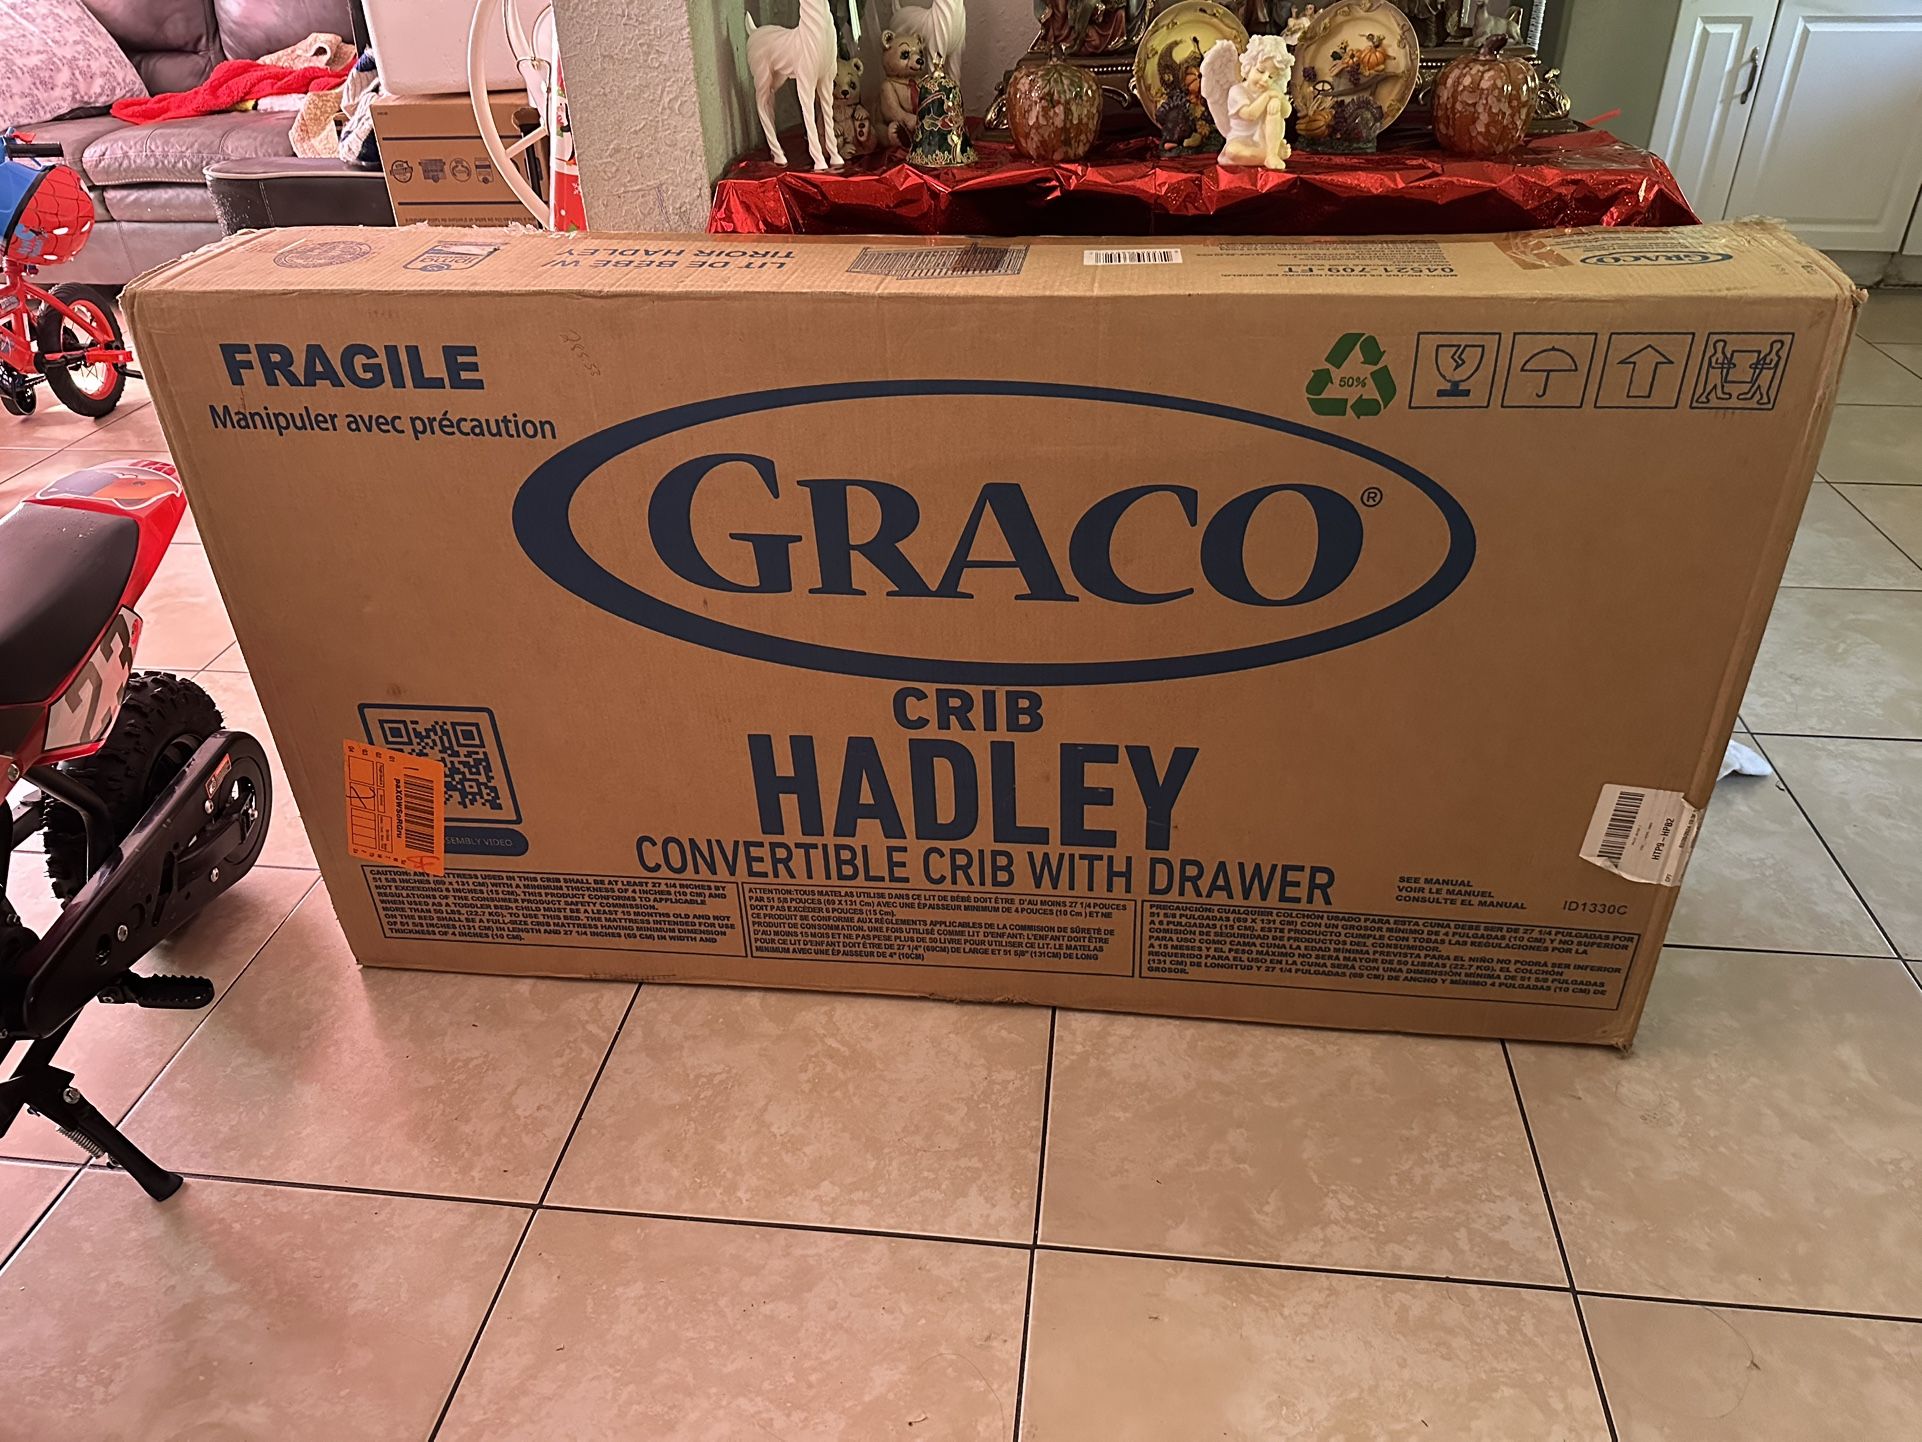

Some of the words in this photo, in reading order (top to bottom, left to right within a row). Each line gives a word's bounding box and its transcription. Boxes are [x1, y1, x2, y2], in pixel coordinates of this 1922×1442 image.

[218, 343, 485, 391] FRAGILE
[1338, 376, 1368, 389] 50%
[209, 403, 339, 438] Manipuler
[345, 412, 405, 434] avec
[410, 408, 557, 442] précaution
[647, 453, 1364, 607] GRACO
[893, 687, 1044, 732] CRIB
[748, 734, 1199, 851] HADLEY
[636, 835, 910, 885] CONVERTIBLE
[923, 847, 1015, 890] CRIB
[1027, 851, 1132, 894] WITH
[1149, 857, 1336, 906] DRAWER
[1398, 876, 1421, 885] SEE
[1423, 877, 1474, 888] MANUAL
[1395, 895, 1458, 905] CONSULTE
[1460, 897, 1475, 906] EL
[1477, 899, 1527, 910] MANUAL
[1397, 885, 1425, 894] VOIR
[1428, 886, 1444, 895] LE
[1446, 888, 1494, 898] MANUEL
[1563, 900, 1628, 915] ID1330C
